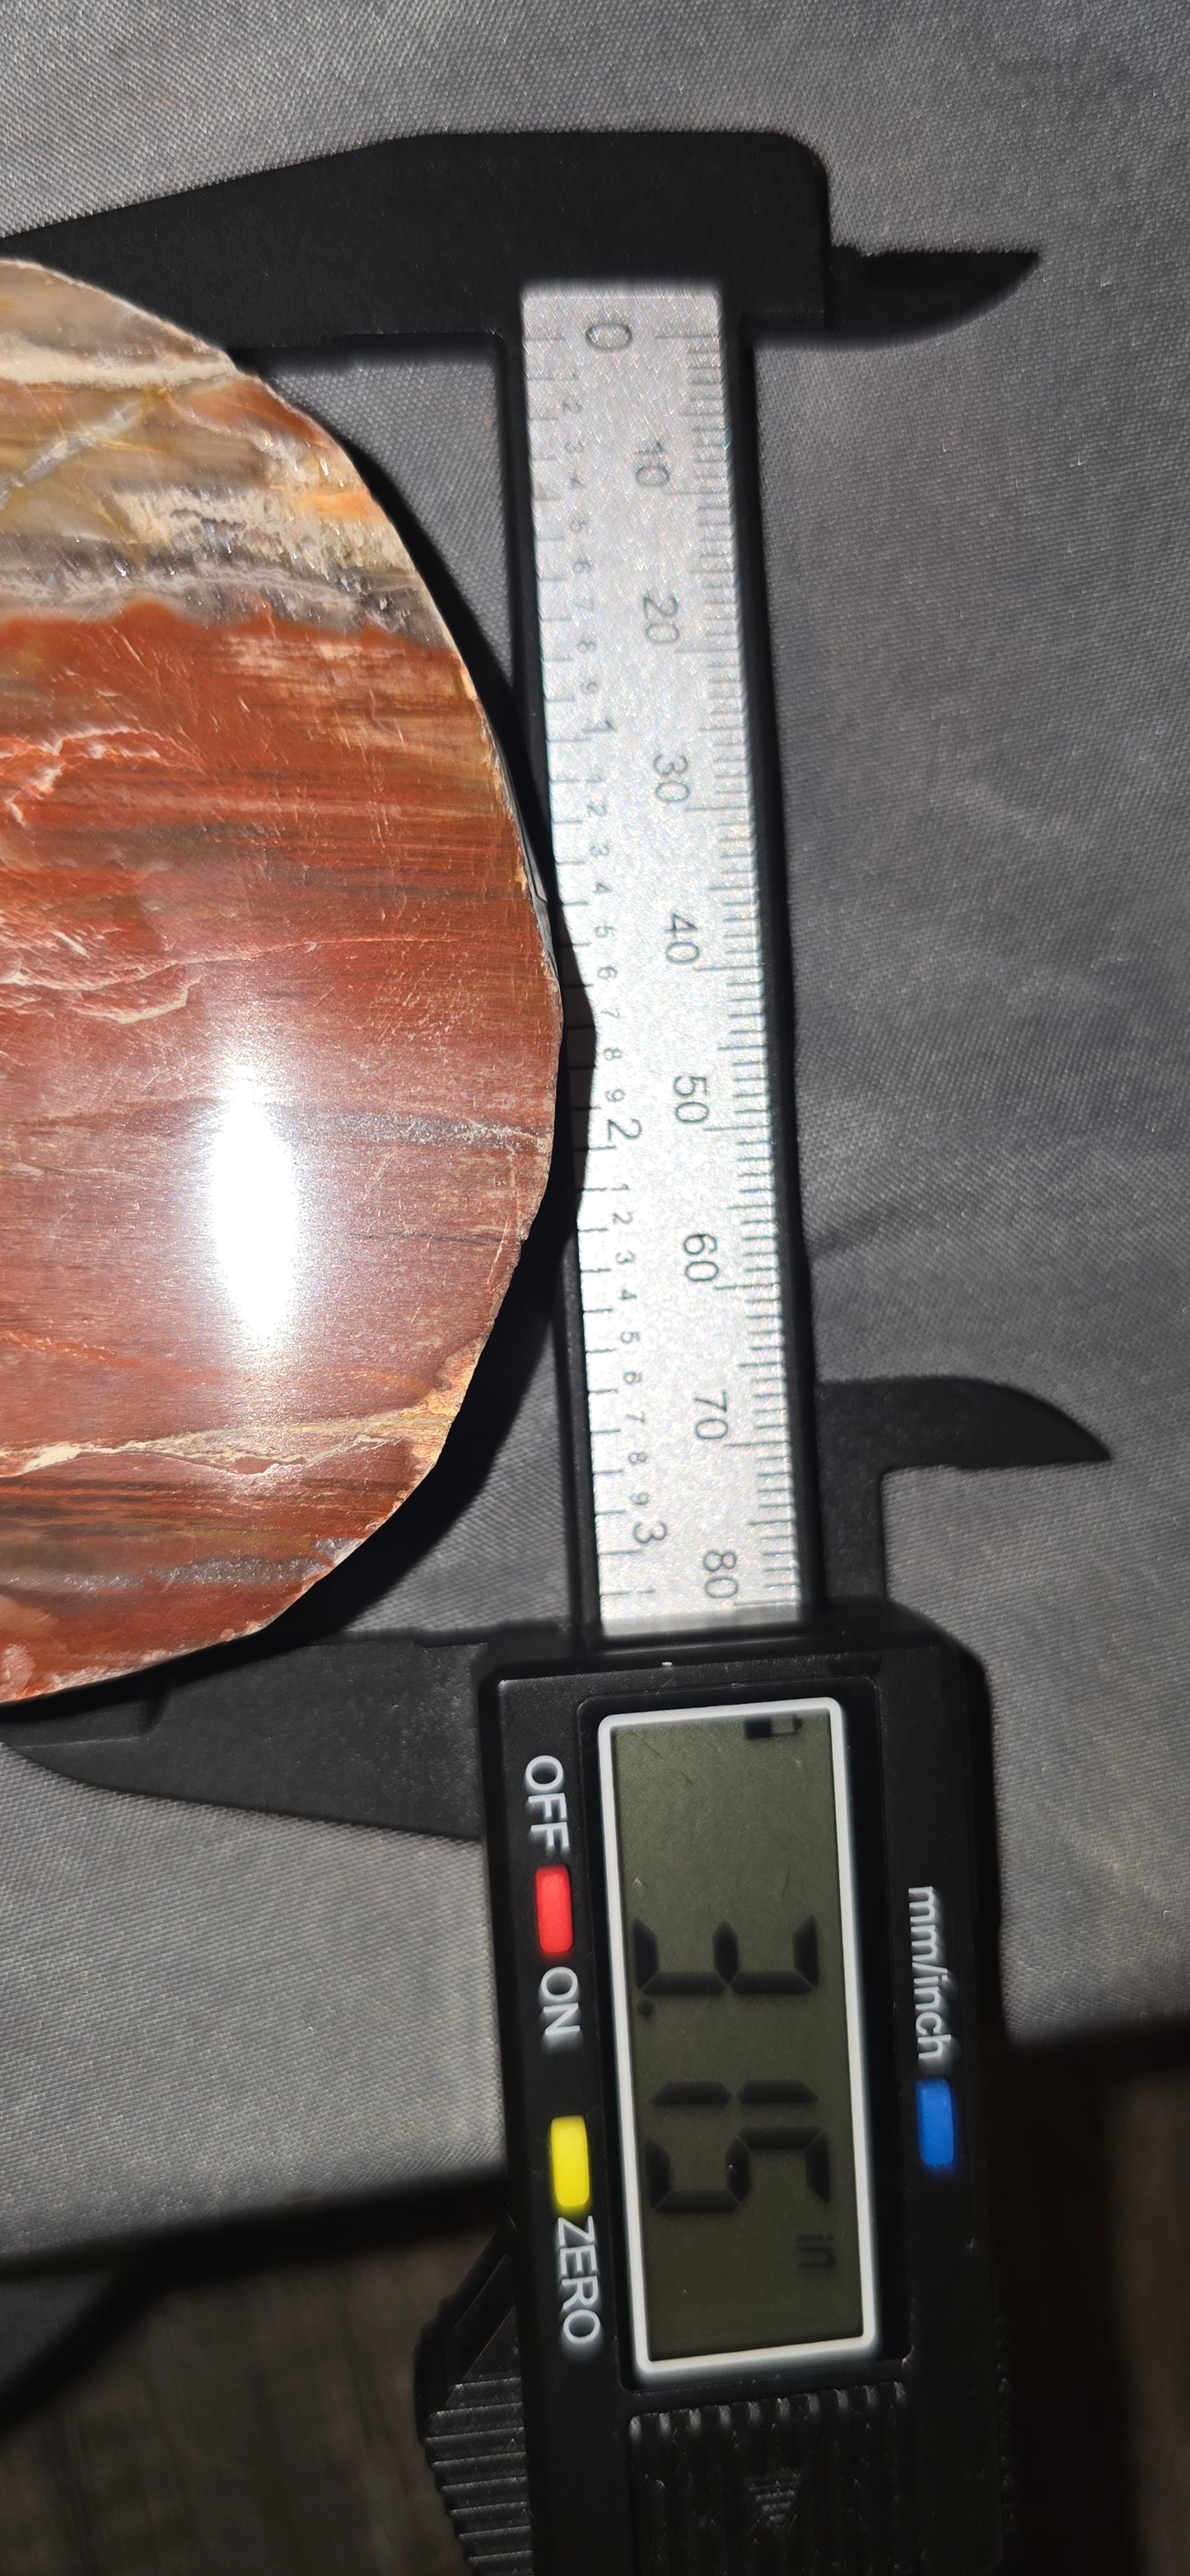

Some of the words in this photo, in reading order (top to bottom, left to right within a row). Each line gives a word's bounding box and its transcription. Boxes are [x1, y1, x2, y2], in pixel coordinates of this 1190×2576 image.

[585, 322, 632, 352] 0
[633, 440, 670, 488] 10
[642, 593, 680, 644] 20
[577, 637, 597, 653] 8
[580, 681, 599, 694] 9
[583, 713, 616, 733] 1
[652, 753, 691, 803] 30
[586, 801, 607, 817] 2
[589, 841, 610, 856] 3
[593, 881, 613, 895] 4
[593, 924, 614, 939] 5
[664, 912, 702, 964] 40
[596, 965, 618, 980] 6
[600, 1006, 619, 1020] 7
[602, 1046, 623, 1061] 8
[604, 1088, 626, 1103] 9
[672, 1075, 710, 1124] 50
[606, 1118, 642, 1141] 2
[611, 1182, 631, 1192] 1
[612, 1211, 634, 1226] 2
[614, 1250, 636, 1266] 3
[682, 1232, 720, 1282] 60
[618, 1289, 637, 1300] 4
[619, 1330, 642, 1345] 5
[622, 1370, 642, 1385] 6
[624, 1410, 646, 1424] 7
[693, 1390, 730, 1440] 70
[627, 1450, 648, 1466] 8
[628, 1491, 650, 1506] 9
[632, 1522, 668, 1545] 3
[702, 1549, 739, 1598] 80
[524, 1754, 569, 1854] OFF
[908, 1885, 954, 2060] mm/inch
[539, 1966, 581, 2038] ON
[632, 1916, 832, 2215] 3.15
[795, 2233, 838, 2270] in
[558, 2215, 601, 2346] ZERO
